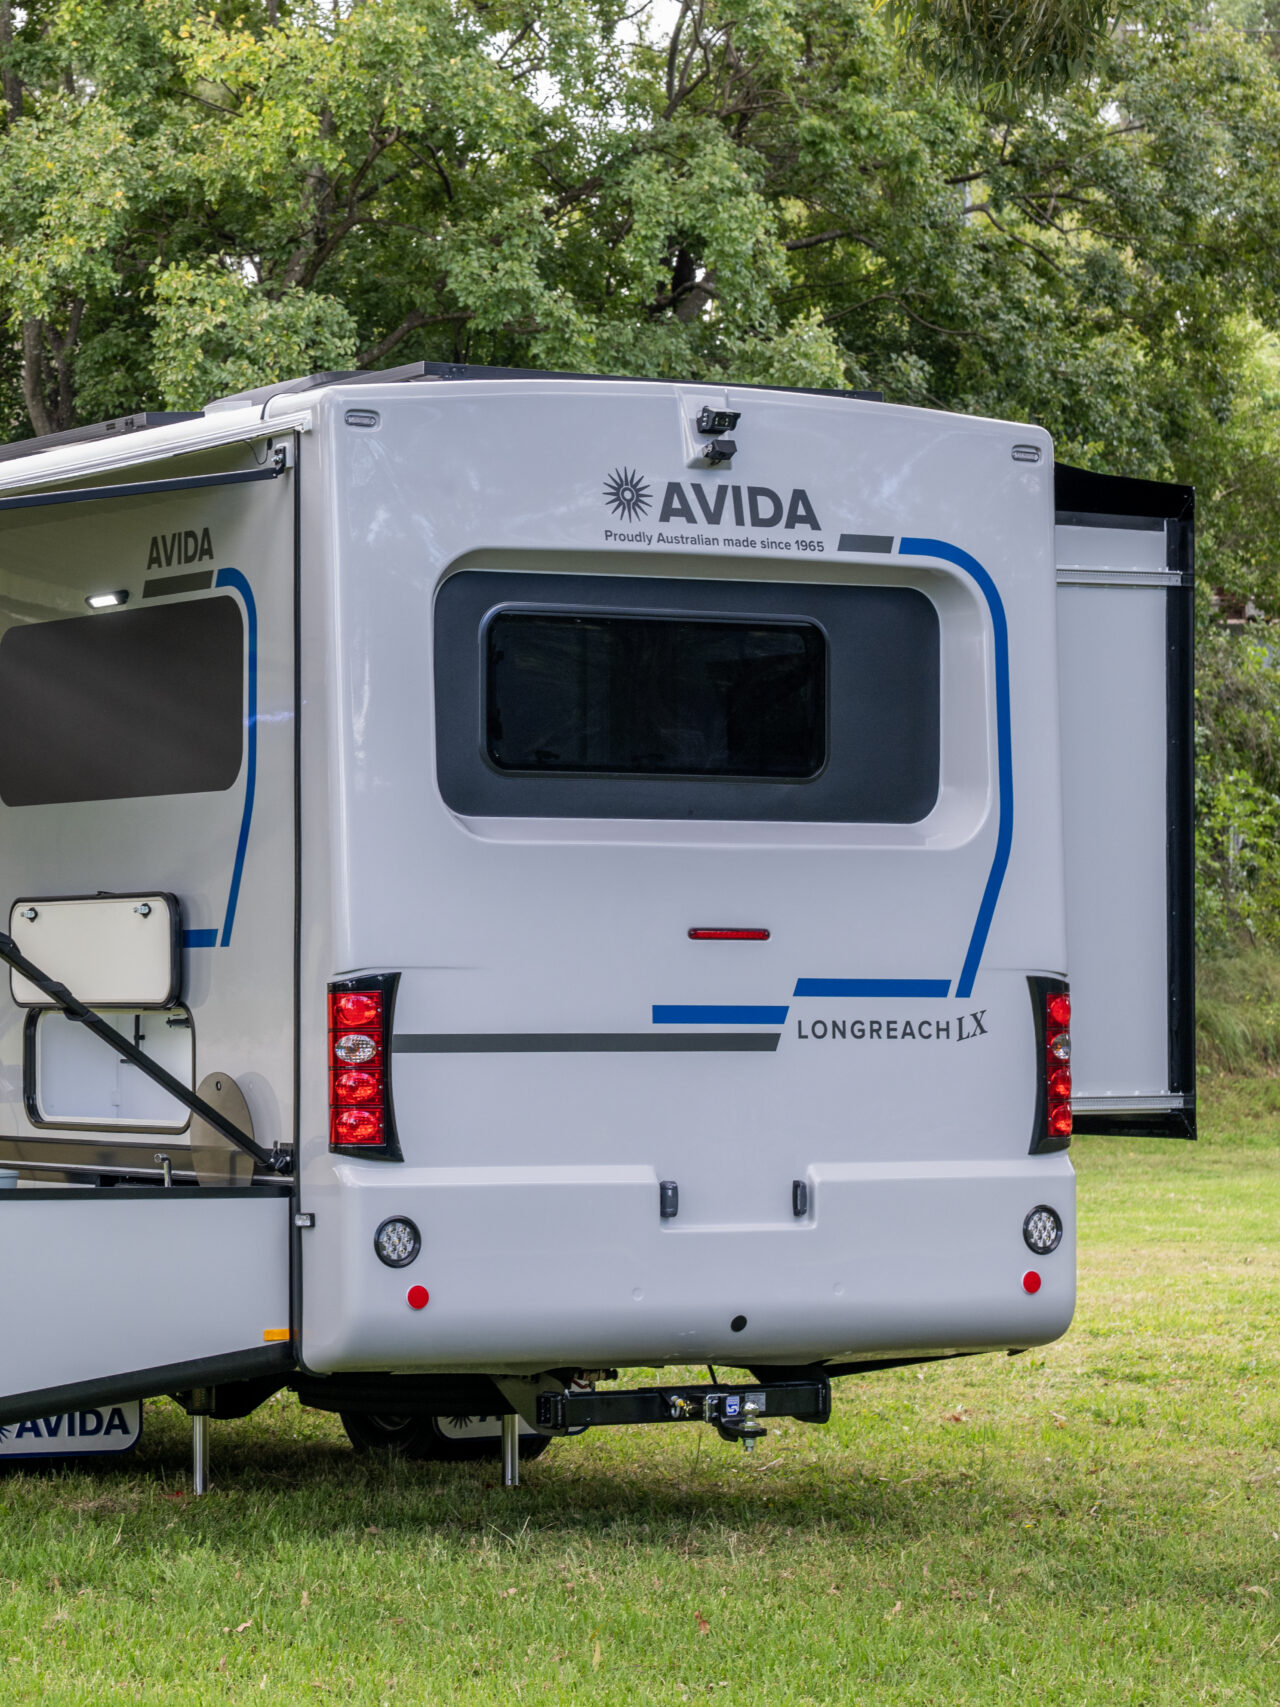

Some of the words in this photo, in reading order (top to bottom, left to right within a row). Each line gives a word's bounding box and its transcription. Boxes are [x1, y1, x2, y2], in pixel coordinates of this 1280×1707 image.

[659, 481, 822, 531] AVIDA
[146, 527, 214, 570] AVIDA
[604, 529, 653, 546] Proudly
[657, 532, 720, 547] Australian
[723, 536, 757, 549] made
[760, 538, 792, 550] since
[794, 539, 825, 552] 1965
[798, 1019, 950, 1040] LONGREACH
[956, 1009, 988, 1041] LX
[15, 1407, 131, 1438] AVIDA
